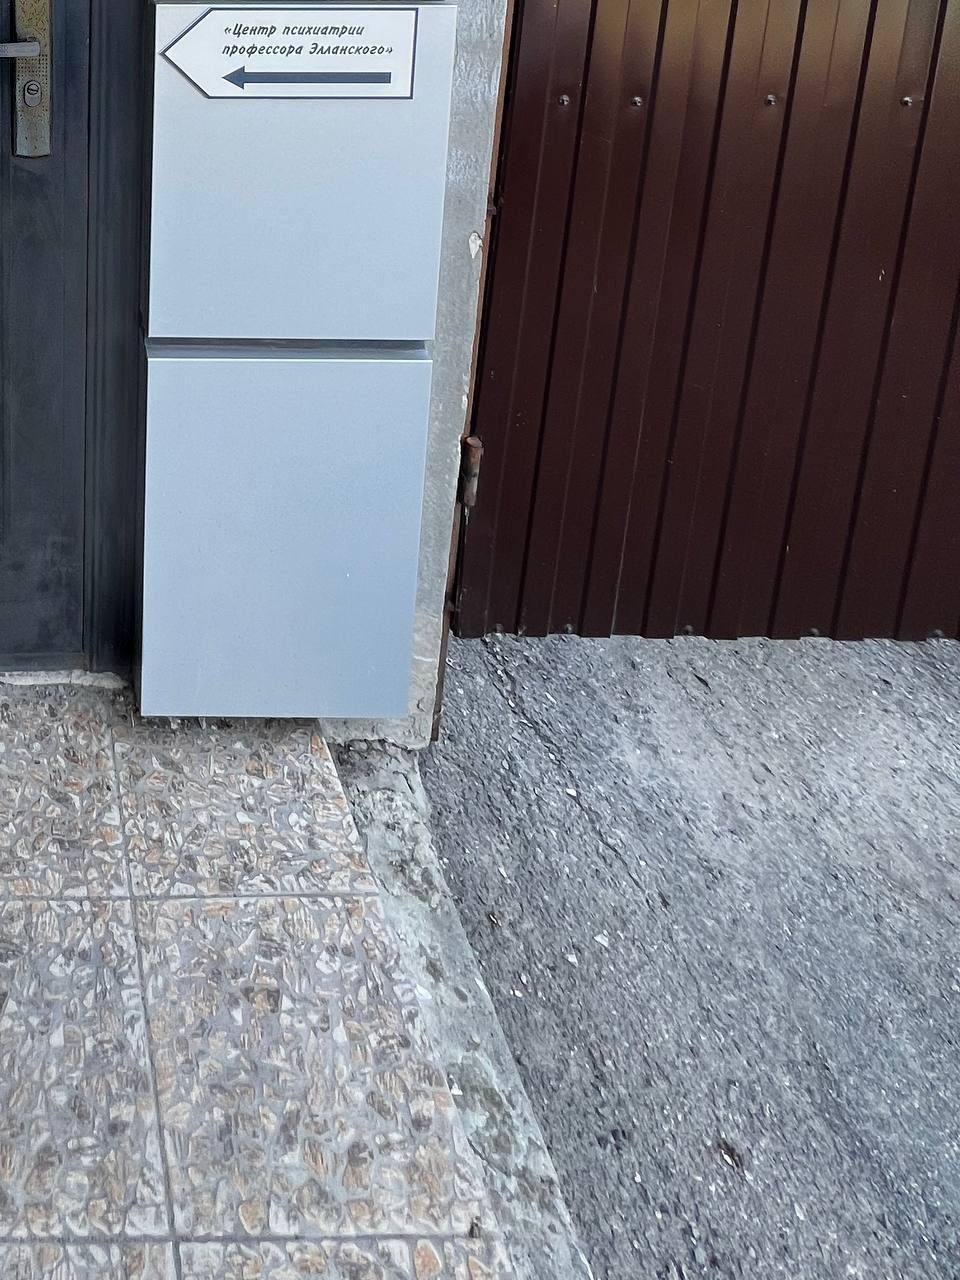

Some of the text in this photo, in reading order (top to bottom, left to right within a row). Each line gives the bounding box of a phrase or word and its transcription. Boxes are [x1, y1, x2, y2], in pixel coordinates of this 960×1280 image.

[224, 23, 365, 37] «Центр психиатрии
[222, 42, 393, 58] профессора Элланского»
